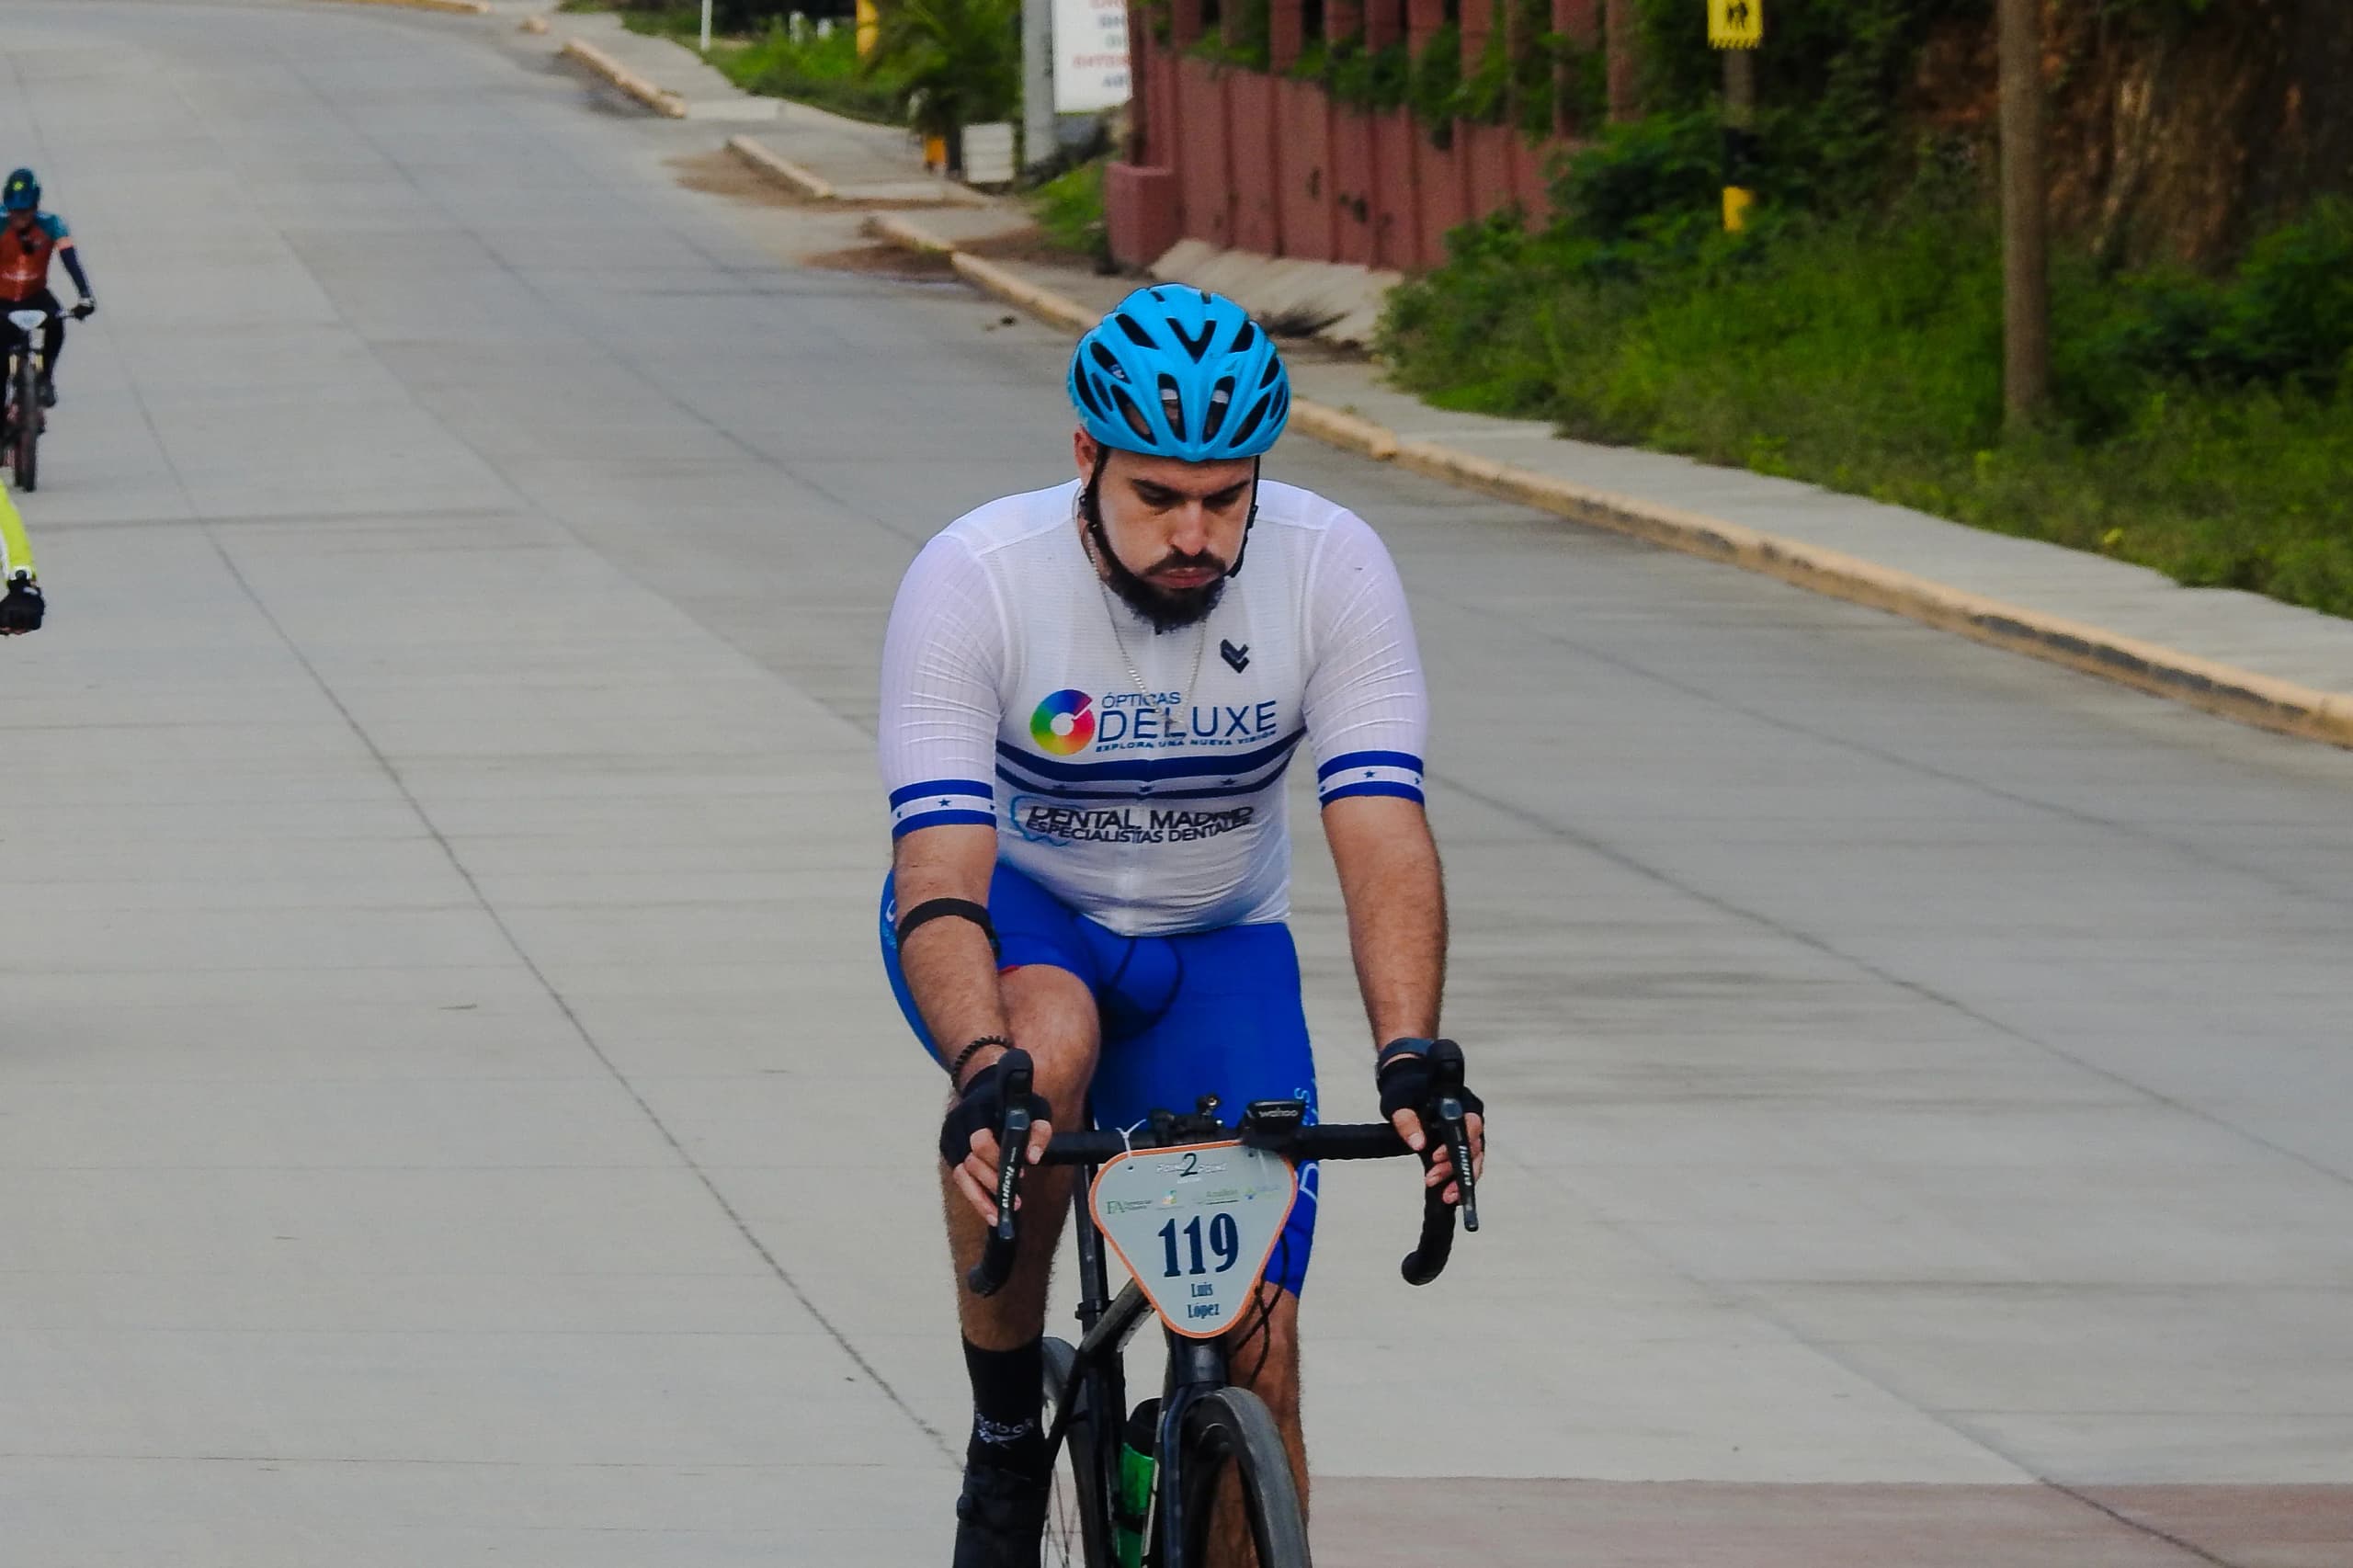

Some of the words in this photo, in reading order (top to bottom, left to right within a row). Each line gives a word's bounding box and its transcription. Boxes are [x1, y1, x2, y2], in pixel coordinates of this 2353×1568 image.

[1097, 699, 1277, 743] DELUXE
[1095, 741, 1154, 753] EXPLORA
[1029, 806, 1143, 830] DENTAL
[1026, 818, 1164, 844] ESPECIALISTAS
[1179, 1152, 1199, 1177] 2
[1157, 1212, 1239, 1278] 119
[1190, 1281, 1213, 1298] Luis
